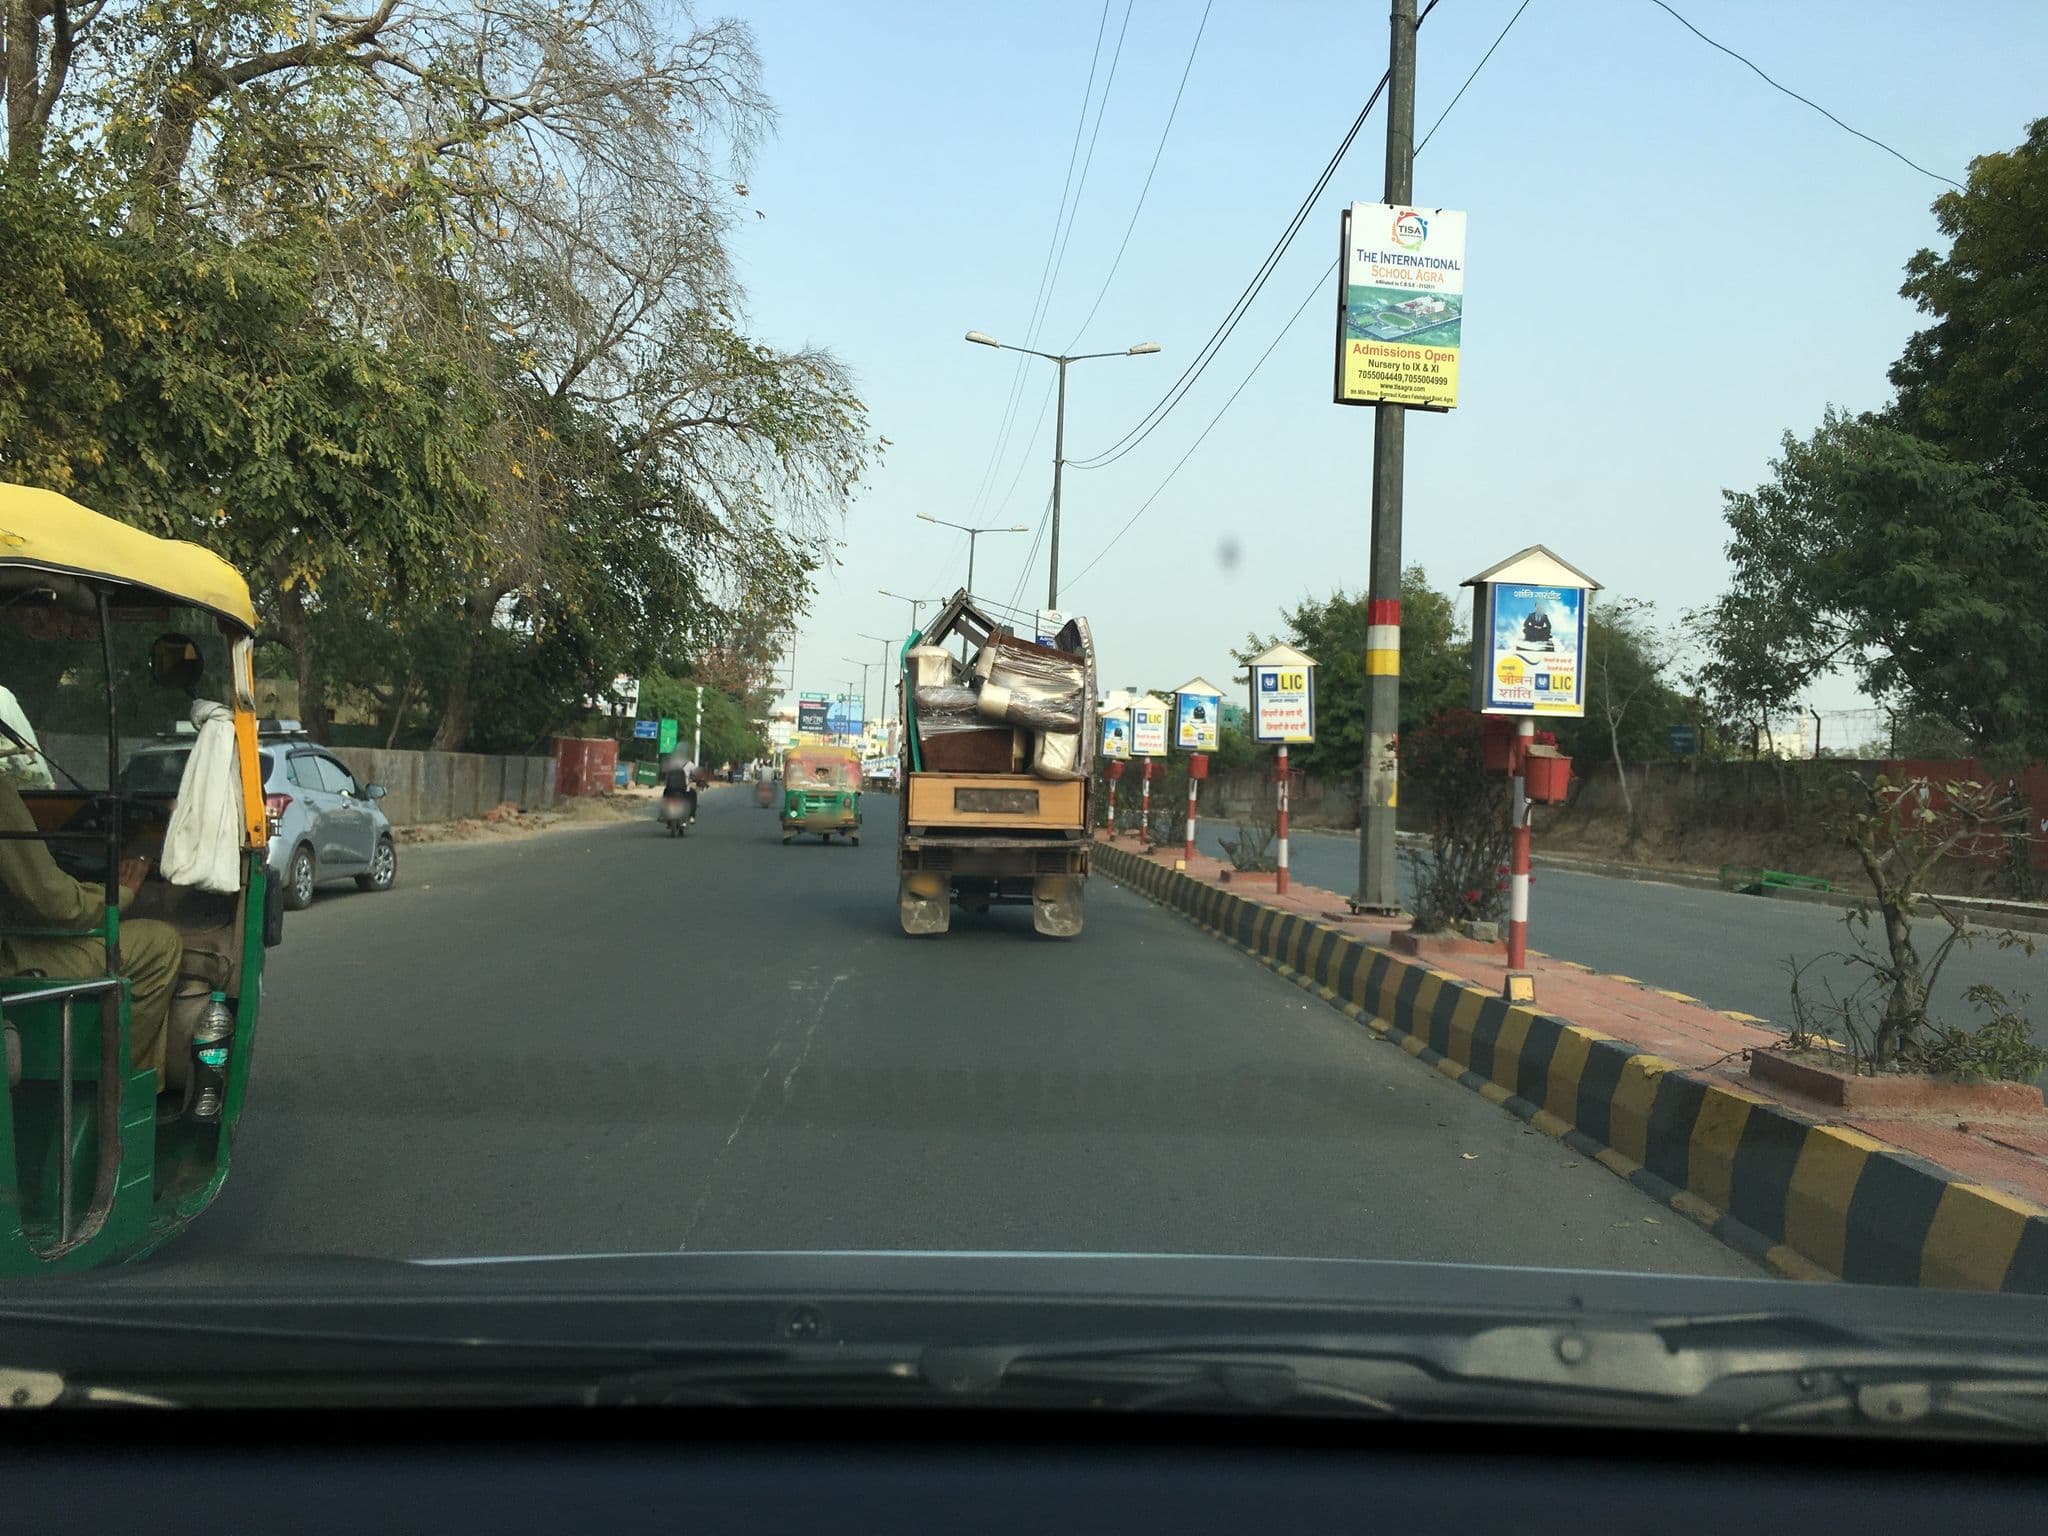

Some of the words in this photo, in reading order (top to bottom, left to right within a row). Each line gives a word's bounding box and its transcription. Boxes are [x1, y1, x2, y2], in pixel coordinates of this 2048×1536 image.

[1398, 225, 1421, 235] TISA
[1357, 249, 1377, 262] THE
[1381, 251, 1460, 270] INTERNATIONAL
[1371, 265, 1413, 280] SCHOOL
[1415, 269, 1444, 283] AGRA
[1353, 344, 1421, 360] Admissions
[1425, 350, 1454, 363] Open
[1368, 359, 1400, 371] Nursery
[1413, 363, 1420, 371] IX
[1423, 364, 1428, 372] &
[1431, 365, 1439, 373] XI
[1380, 383, 1425, 392] www.tisagra.com
[1281, 675, 1302, 690] LIC
[1498, 672, 1533, 685] जीवन
[1552, 676, 1572, 690] LIC
[1498, 686, 1532, 699] शांति
[1149, 714, 1161, 724] LIC
